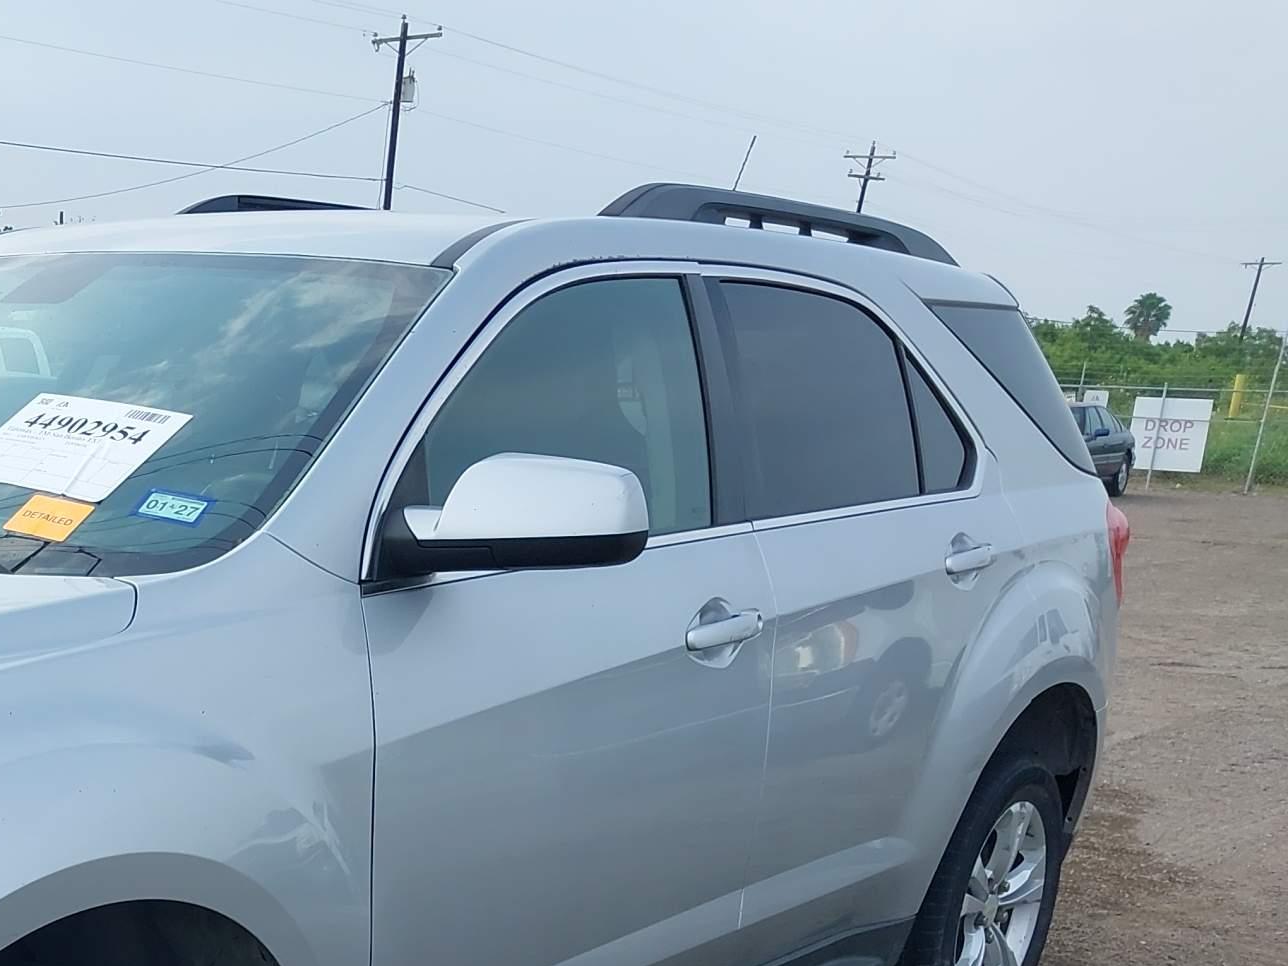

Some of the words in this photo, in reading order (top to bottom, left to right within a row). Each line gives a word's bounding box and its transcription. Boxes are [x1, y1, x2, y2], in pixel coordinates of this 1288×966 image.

[24, 412, 151, 445] 44902954
[1144, 419, 1194, 433] DROP
[1142, 436, 1190, 450] ZONE
[21, 509, 73, 527] DETAILED
